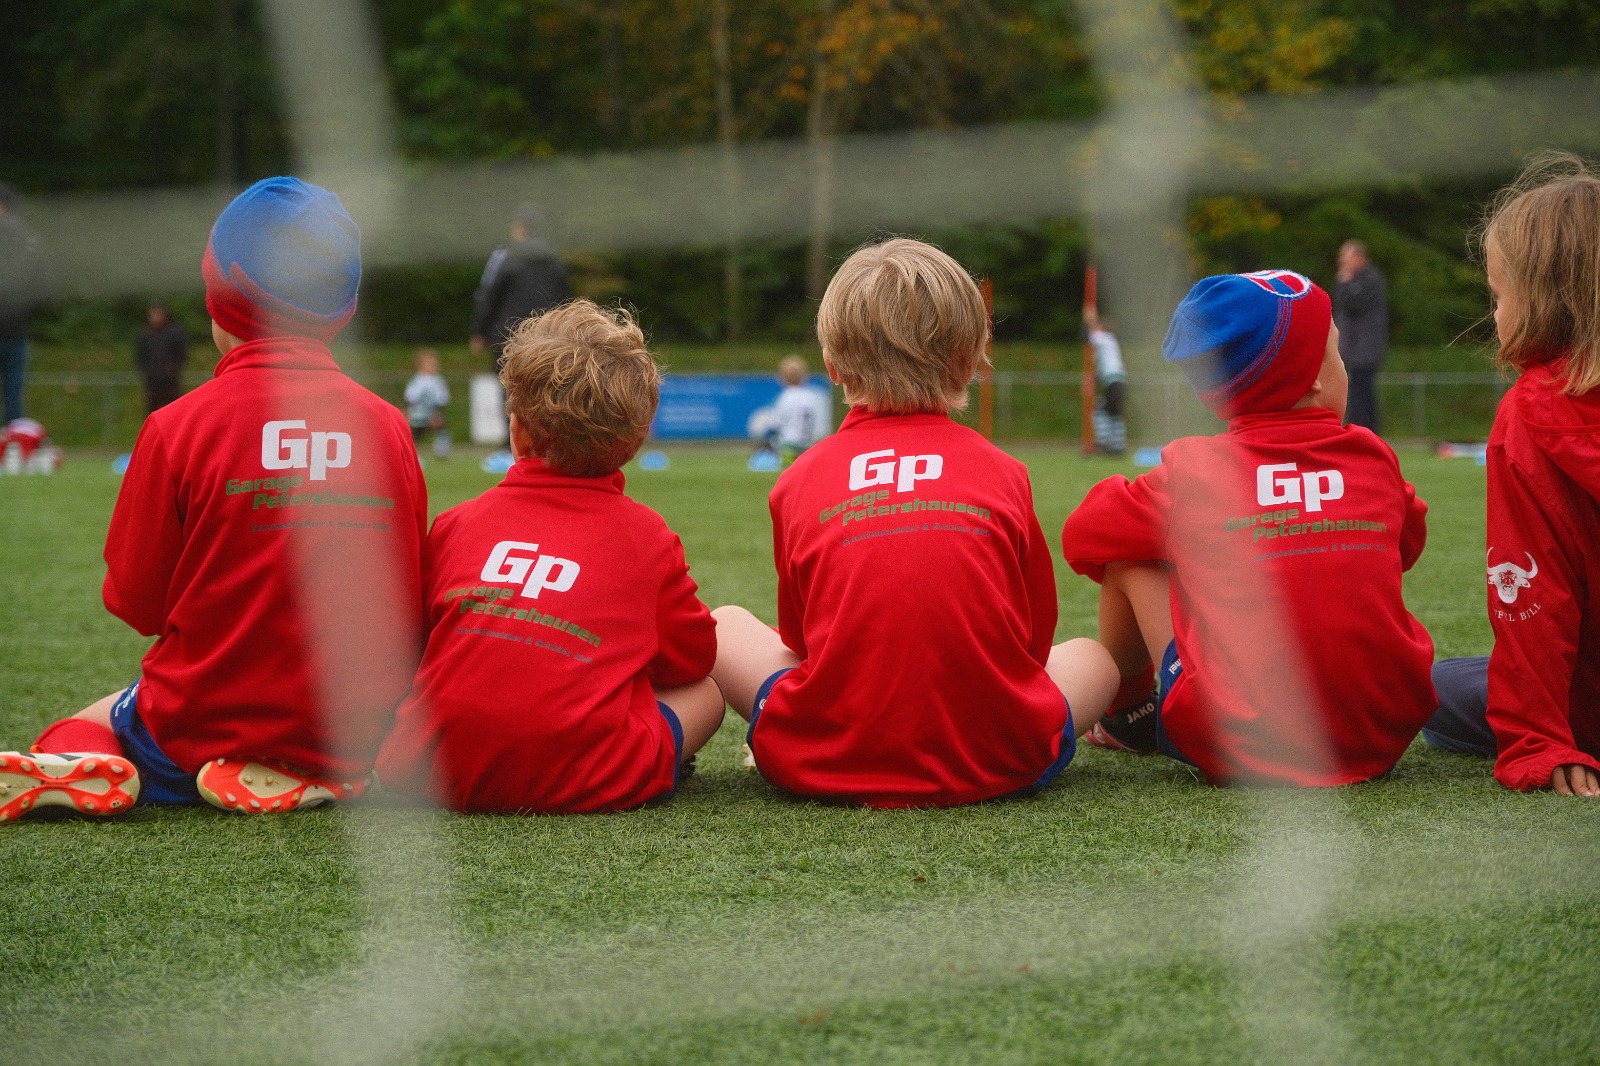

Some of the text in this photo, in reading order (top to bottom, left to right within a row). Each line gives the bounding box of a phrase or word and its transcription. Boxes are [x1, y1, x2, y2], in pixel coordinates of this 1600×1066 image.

[262, 420, 351, 480] Gp
[849, 449, 943, 492] Gp
[226, 475, 304, 496] Garage
[1257, 462, 1344, 512] Gp
[253, 490, 394, 510] Petershausen
[819, 489, 890, 524] Garage
[842, 498, 991, 526] Petershausen
[1225, 508, 1299, 532] Garage
[1253, 519, 1387, 542] Petershausen
[480, 541, 580, 599] Gp
[446, 586, 514, 602] Garage
[460, 598, 602, 648] Petershausen
[1520, 602, 1541, 620] BILL
[1126, 702, 1155, 724] JAKO
